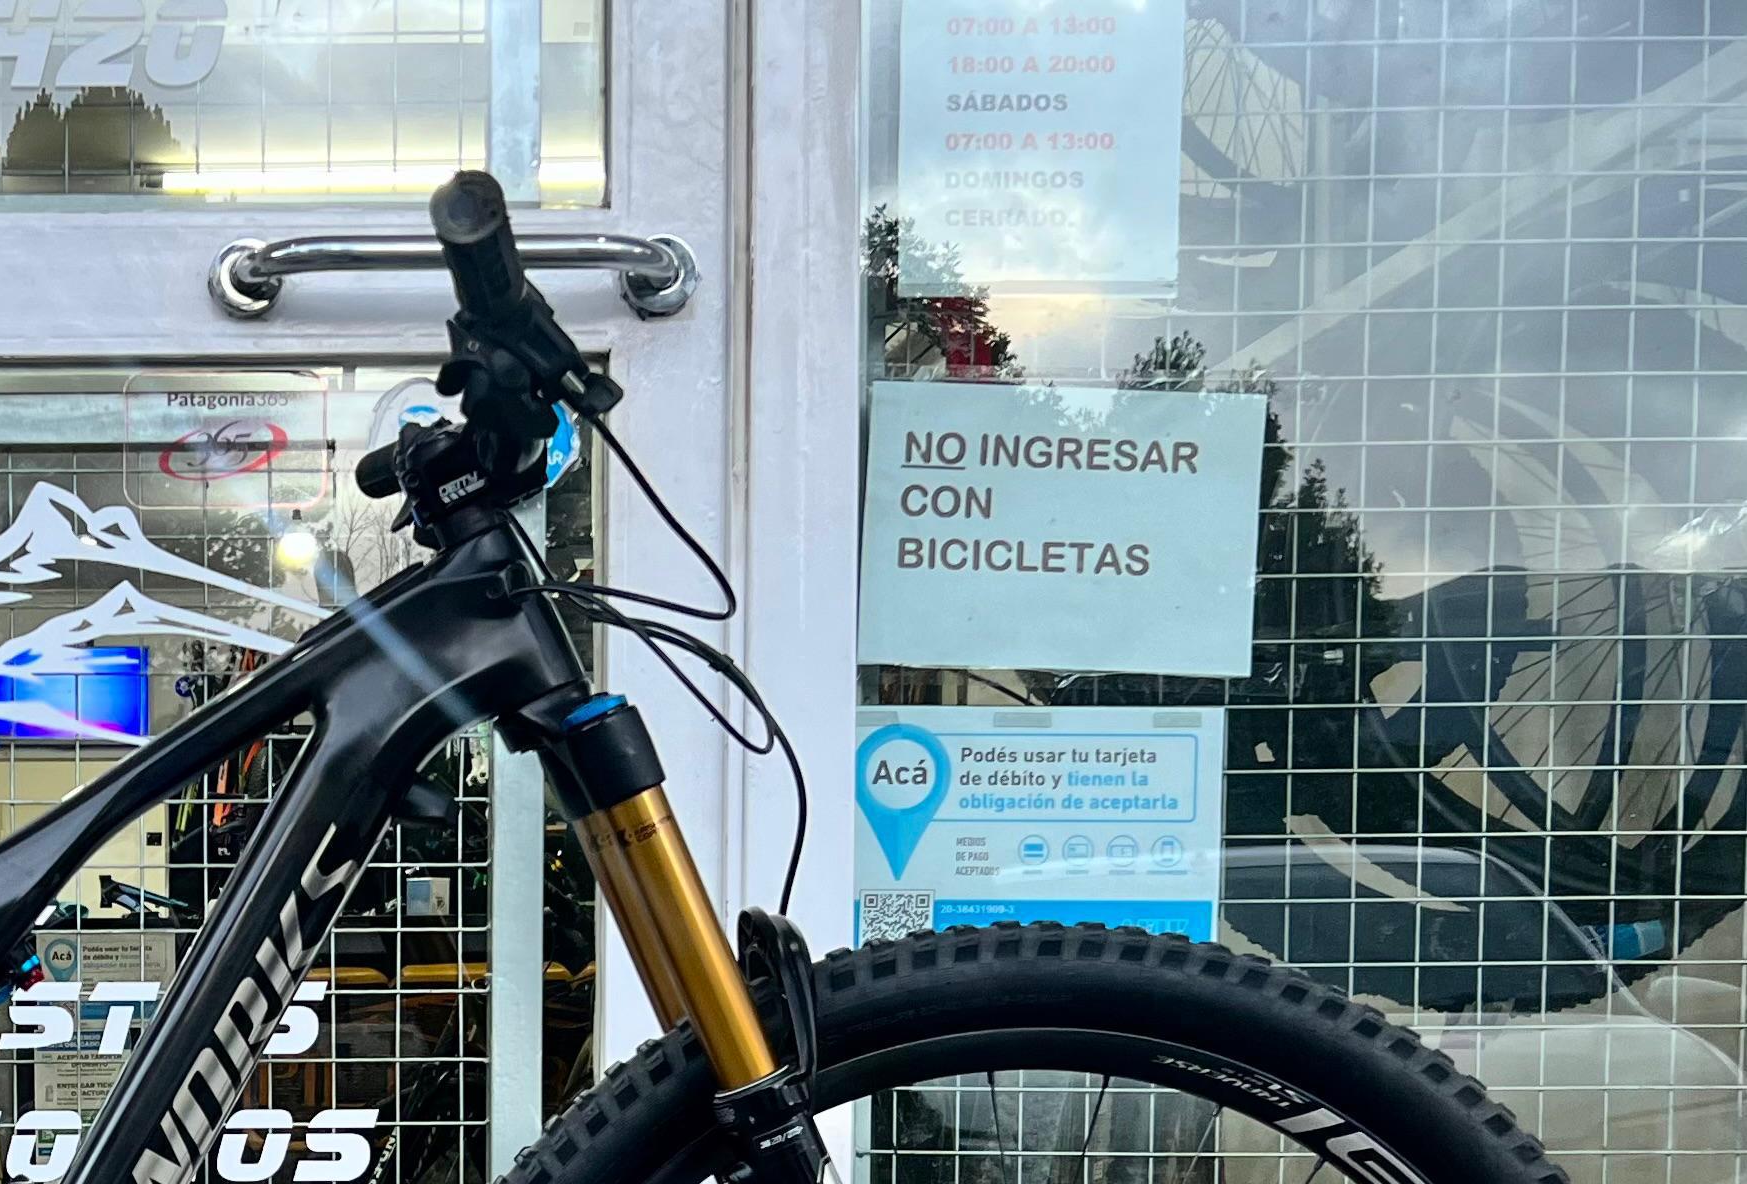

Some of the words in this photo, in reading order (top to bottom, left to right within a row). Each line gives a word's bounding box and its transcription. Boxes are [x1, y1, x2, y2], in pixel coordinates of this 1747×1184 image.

[946, 16, 1014, 36] 07:00
[1022, 17, 1039, 35] A
[1049, 16, 1116, 35] 13:00
[948, 56, 1014, 74] 18:00
[1022, 56, 1040, 73] A
[1048, 56, 1116, 73] 20:00
[946, 90, 1068, 111] SÁBADOS
[945, 132, 1013, 151] 07:00
[1021, 132, 1038, 150] A
[1047, 132, 1115, 150] 13:00
[944, 171, 1085, 189] DOMINGOS
[904, 431, 966, 467] NO
[979, 433, 1199, 474] INGRESAR
[900, 484, 992, 519] CON
[897, 537, 1150, 576] BICICLETAS
[960, 747, 1017, 763] Podés
[1024, 751, 1066, 763] usar
[1071, 749, 1089, 763] tu
[1095, 749, 1157, 766] tarjeta
[872, 759, 928, 786] Acá
[959, 771, 982, 786] de
[1051, 774, 1062, 789] y
[1068, 771, 1125, 786] tienen
[1131, 771, 1149, 786] la
[959, 793, 1054, 812] obligación
[1061, 794, 1083, 810] de
[1089, 793, 1178, 812] aceptarla
[956, 837, 987, 847] MEDIOS
[955, 852, 967, 862] DE
[968, 852, 989, 862] PAGO
[51, 950, 72, 961] Acá
